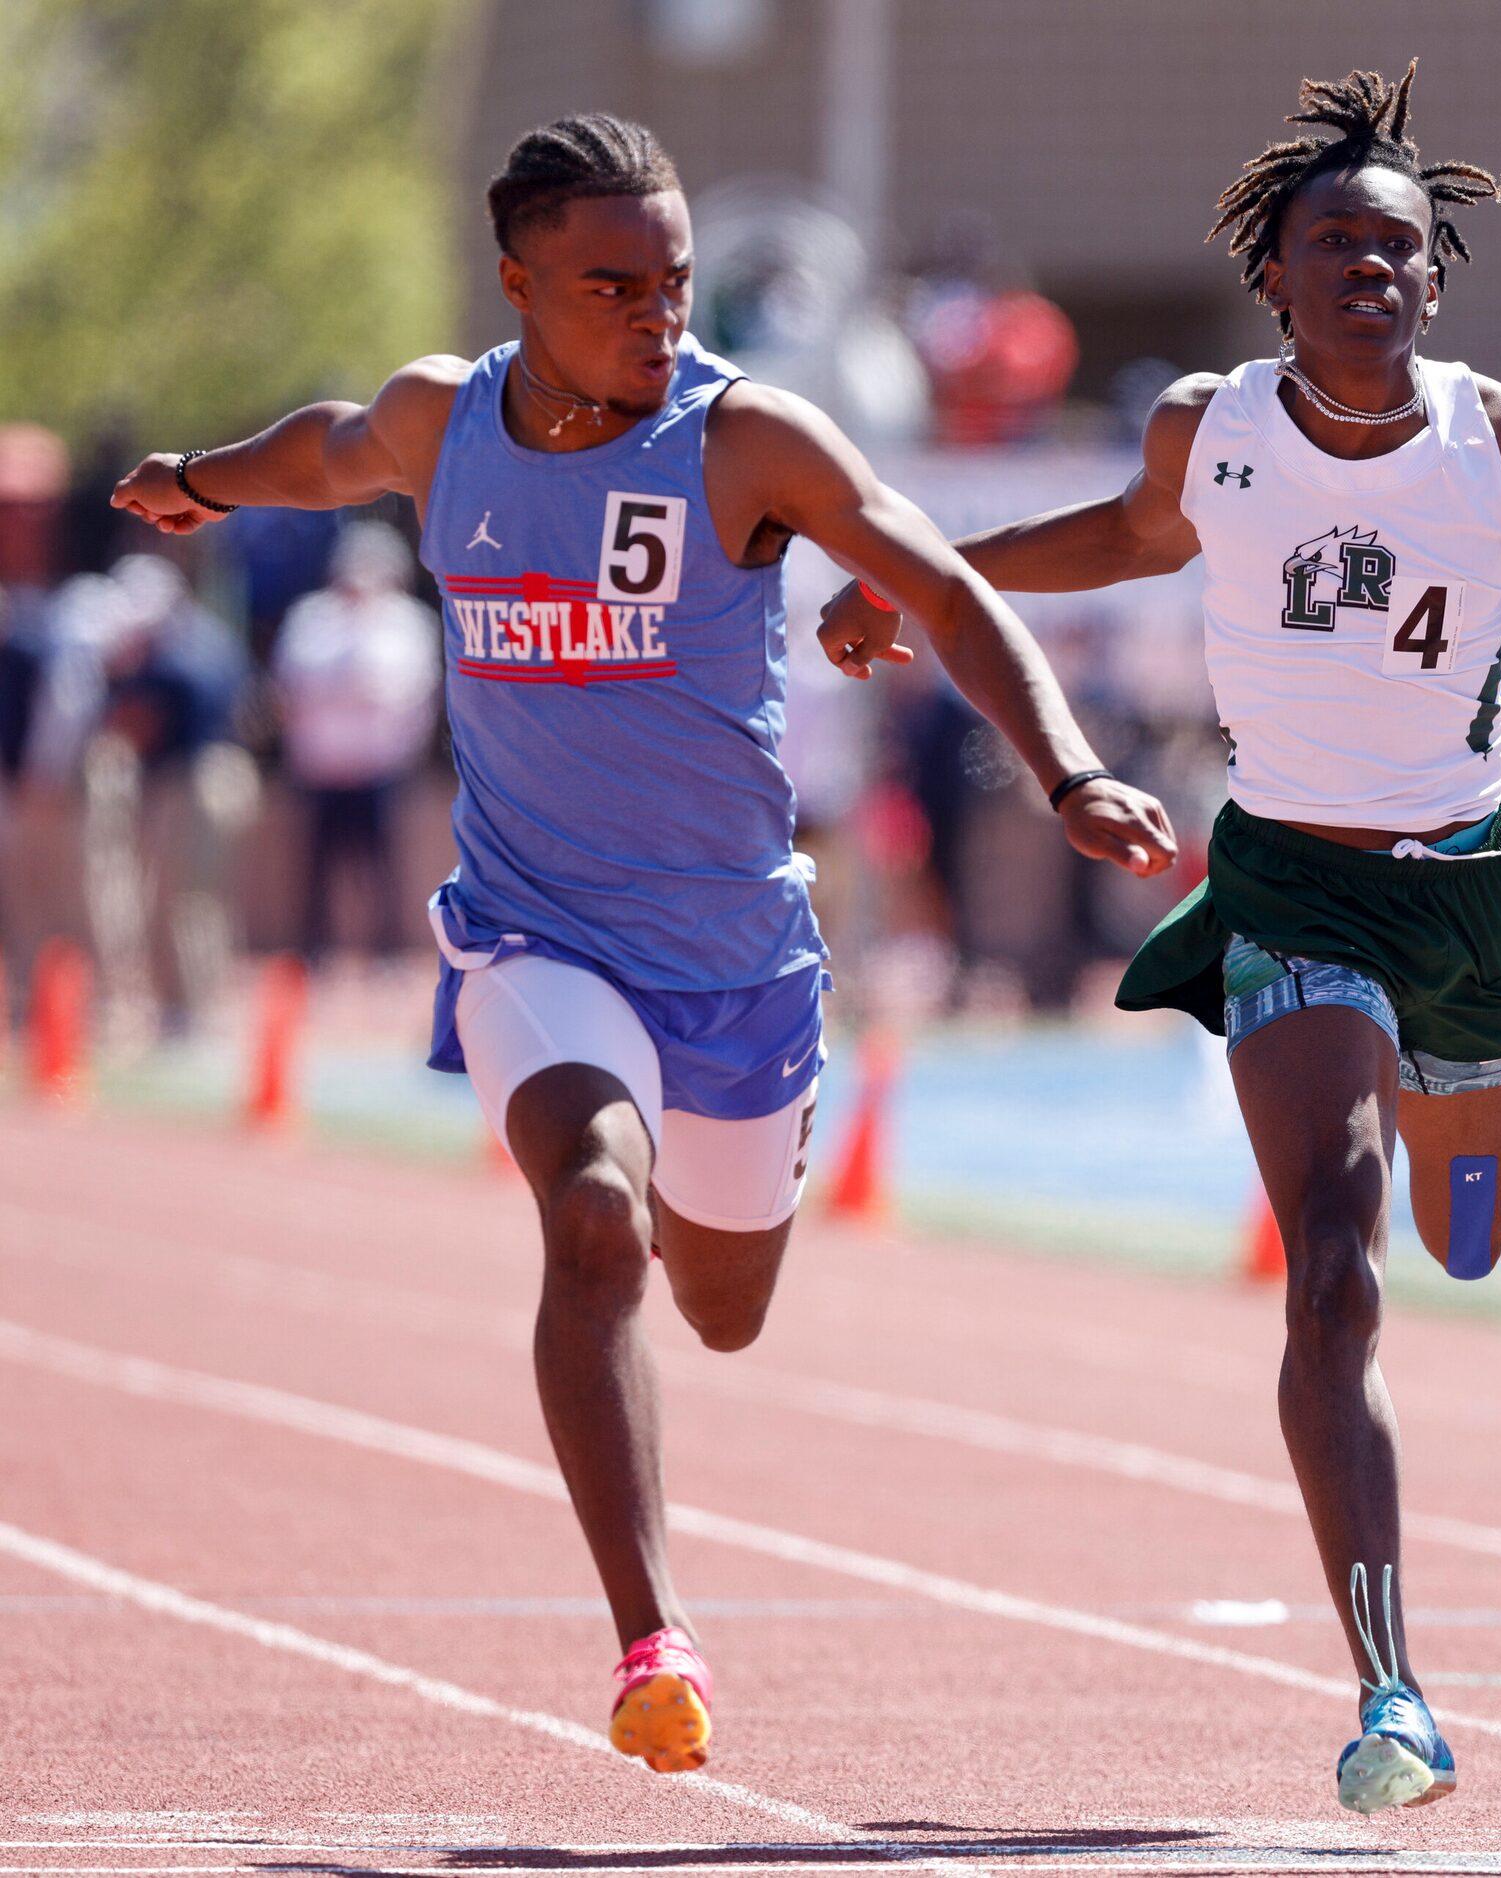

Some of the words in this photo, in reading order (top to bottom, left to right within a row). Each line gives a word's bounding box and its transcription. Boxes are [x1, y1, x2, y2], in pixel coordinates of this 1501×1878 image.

[608, 501, 668, 595] 5
[453, 598, 668, 661] WESTLAKE
[1393, 585, 1449, 670] 4
[1465, 1171, 1483, 1183] KT
